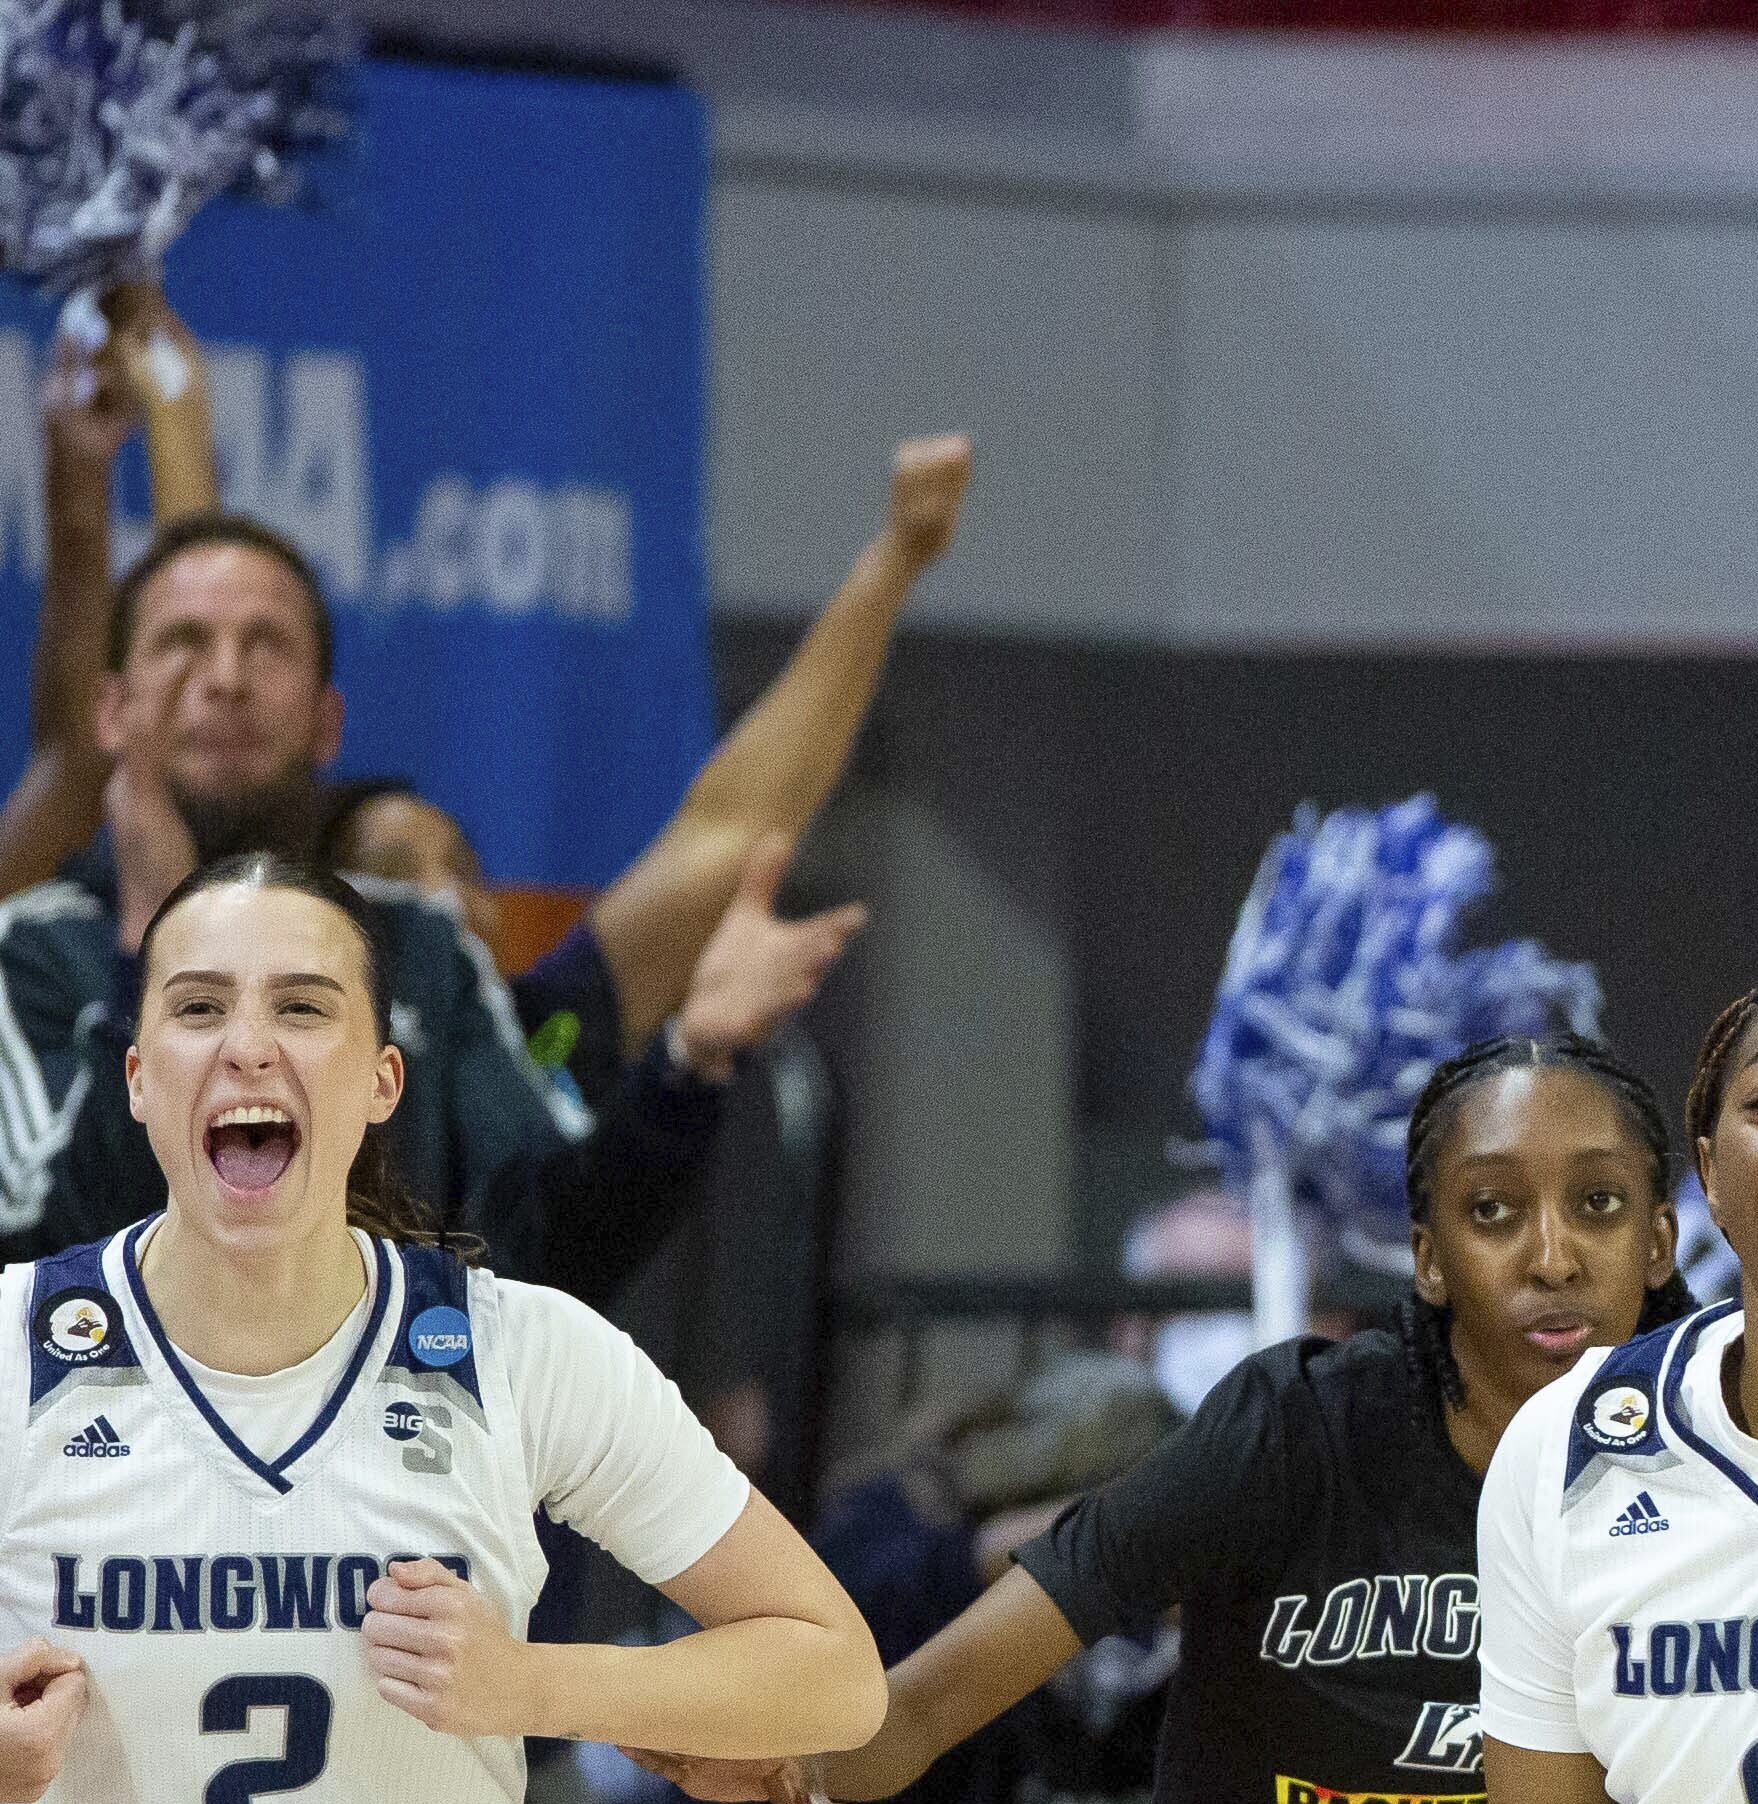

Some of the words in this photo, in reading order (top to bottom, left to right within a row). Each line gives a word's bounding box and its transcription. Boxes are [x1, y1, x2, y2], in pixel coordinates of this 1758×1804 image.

[43, 1340, 73, 1361] United
[75, 1353, 88, 1361] As
[89, 1343, 110, 1358] One
[417, 1334, 468, 1350] NCAA
[384, 1411, 424, 1431] BIG
[63, 1441, 131, 1458] adidas
[1608, 1518, 1670, 1537] adidas
[51, 1553, 471, 1634] LONGWO
